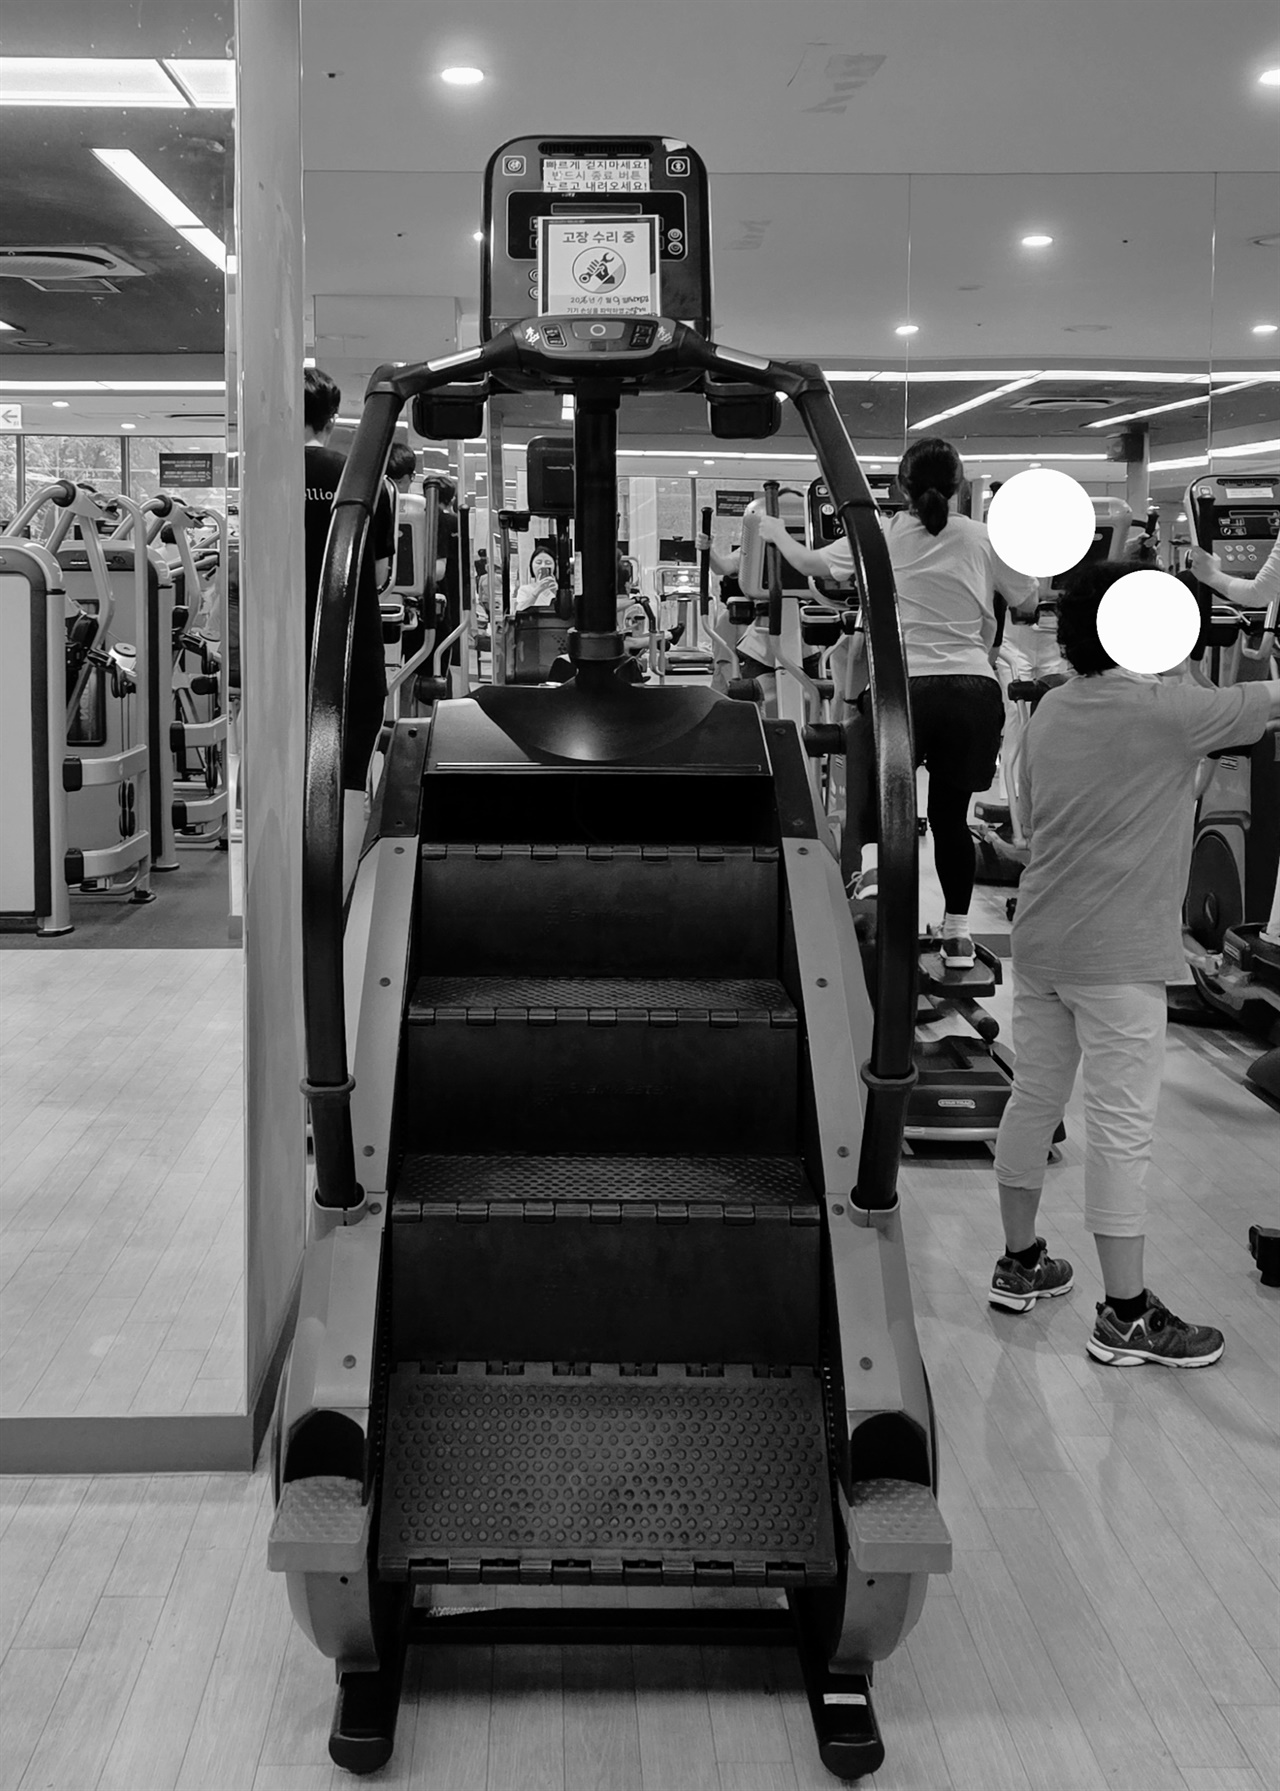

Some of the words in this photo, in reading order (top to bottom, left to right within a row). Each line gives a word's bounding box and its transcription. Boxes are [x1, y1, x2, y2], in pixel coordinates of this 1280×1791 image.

[546, 161, 580, 170] 빠르게
[586, 161, 647, 170] 걷지마세요!
[552, 171, 585, 180] 반드시
[592, 171, 613, 180] 종료
[619, 171, 641, 180] 버튼
[547, 182, 580, 192] 누르고
[586, 182, 647, 192] 내려오세요!
[563, 231, 589, 243] 고장
[592, 231, 618, 243] 수리
[622, 231, 635, 243] 중
